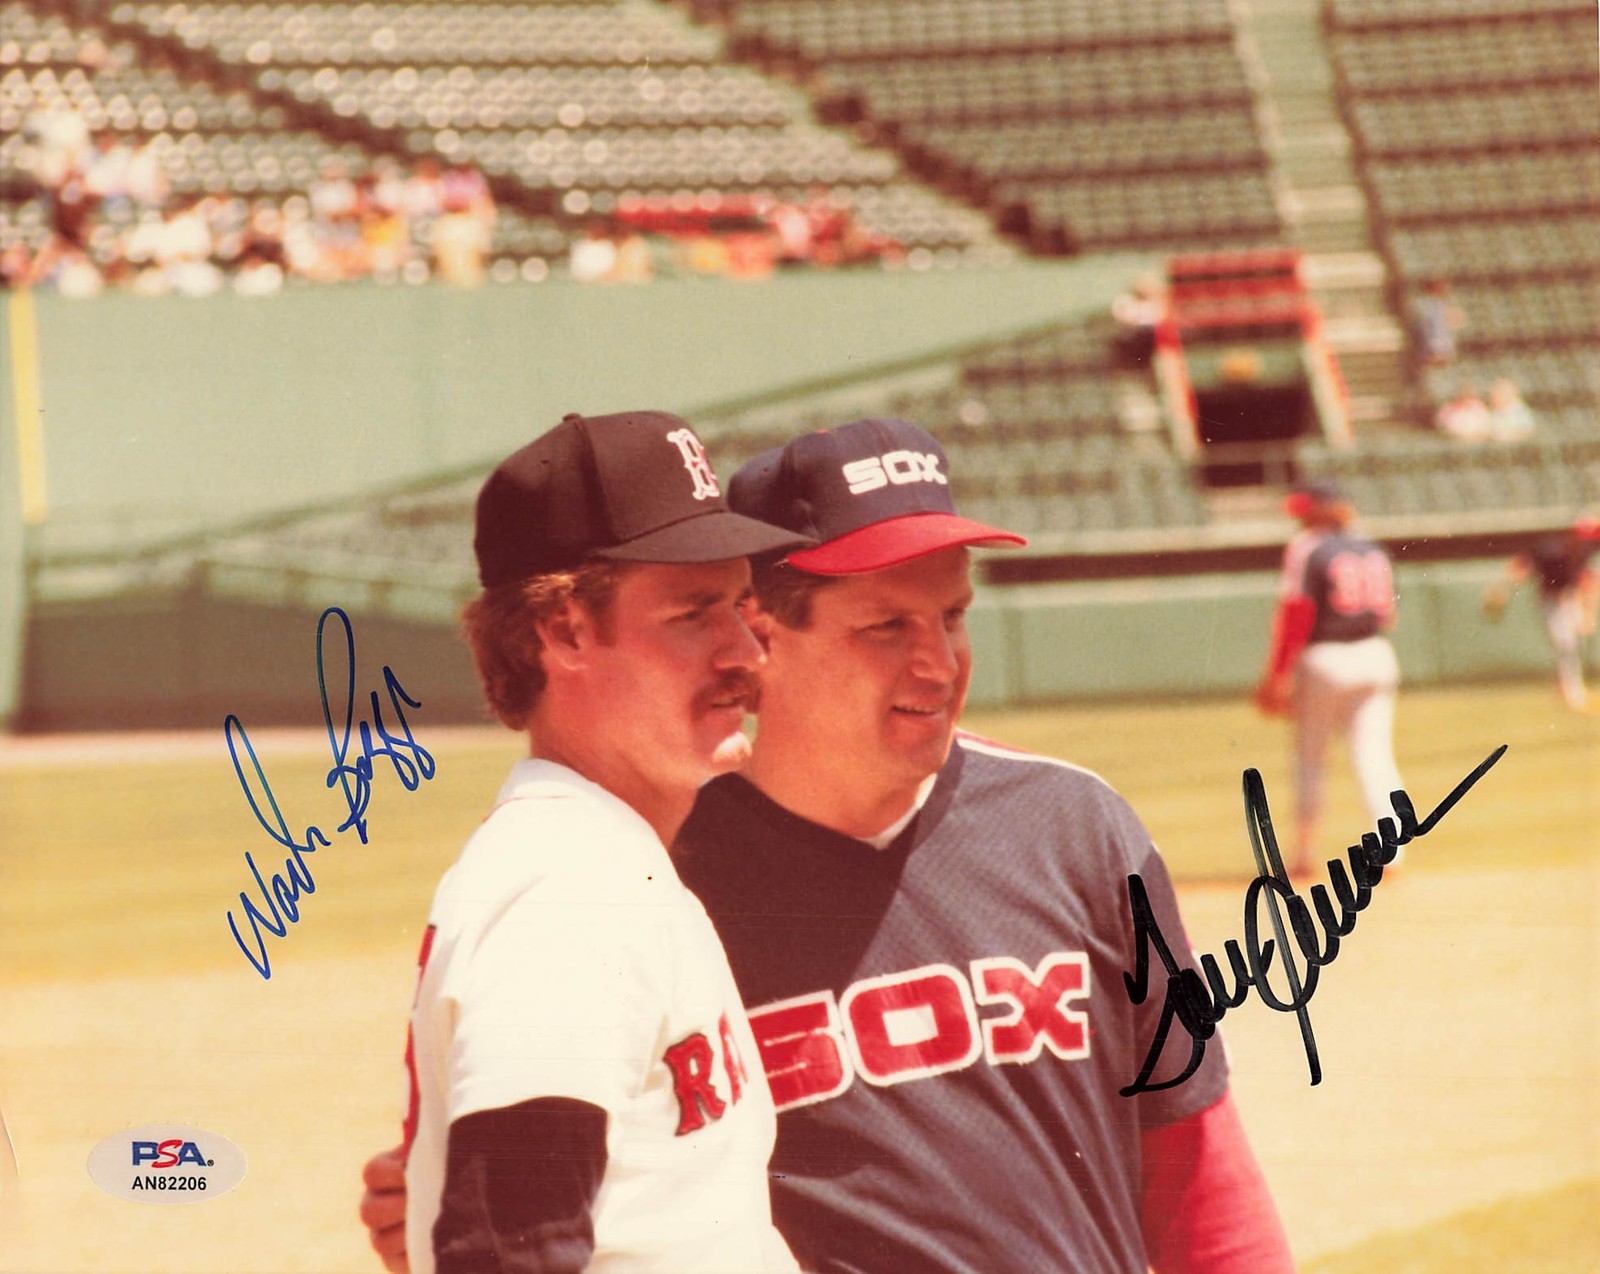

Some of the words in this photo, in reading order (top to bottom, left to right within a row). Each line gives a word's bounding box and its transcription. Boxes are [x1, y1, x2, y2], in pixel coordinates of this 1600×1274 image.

[842, 449, 948, 495] SOX
[745, 952, 1092, 1114] SOX
[131, 1176, 207, 1190] AN82206
